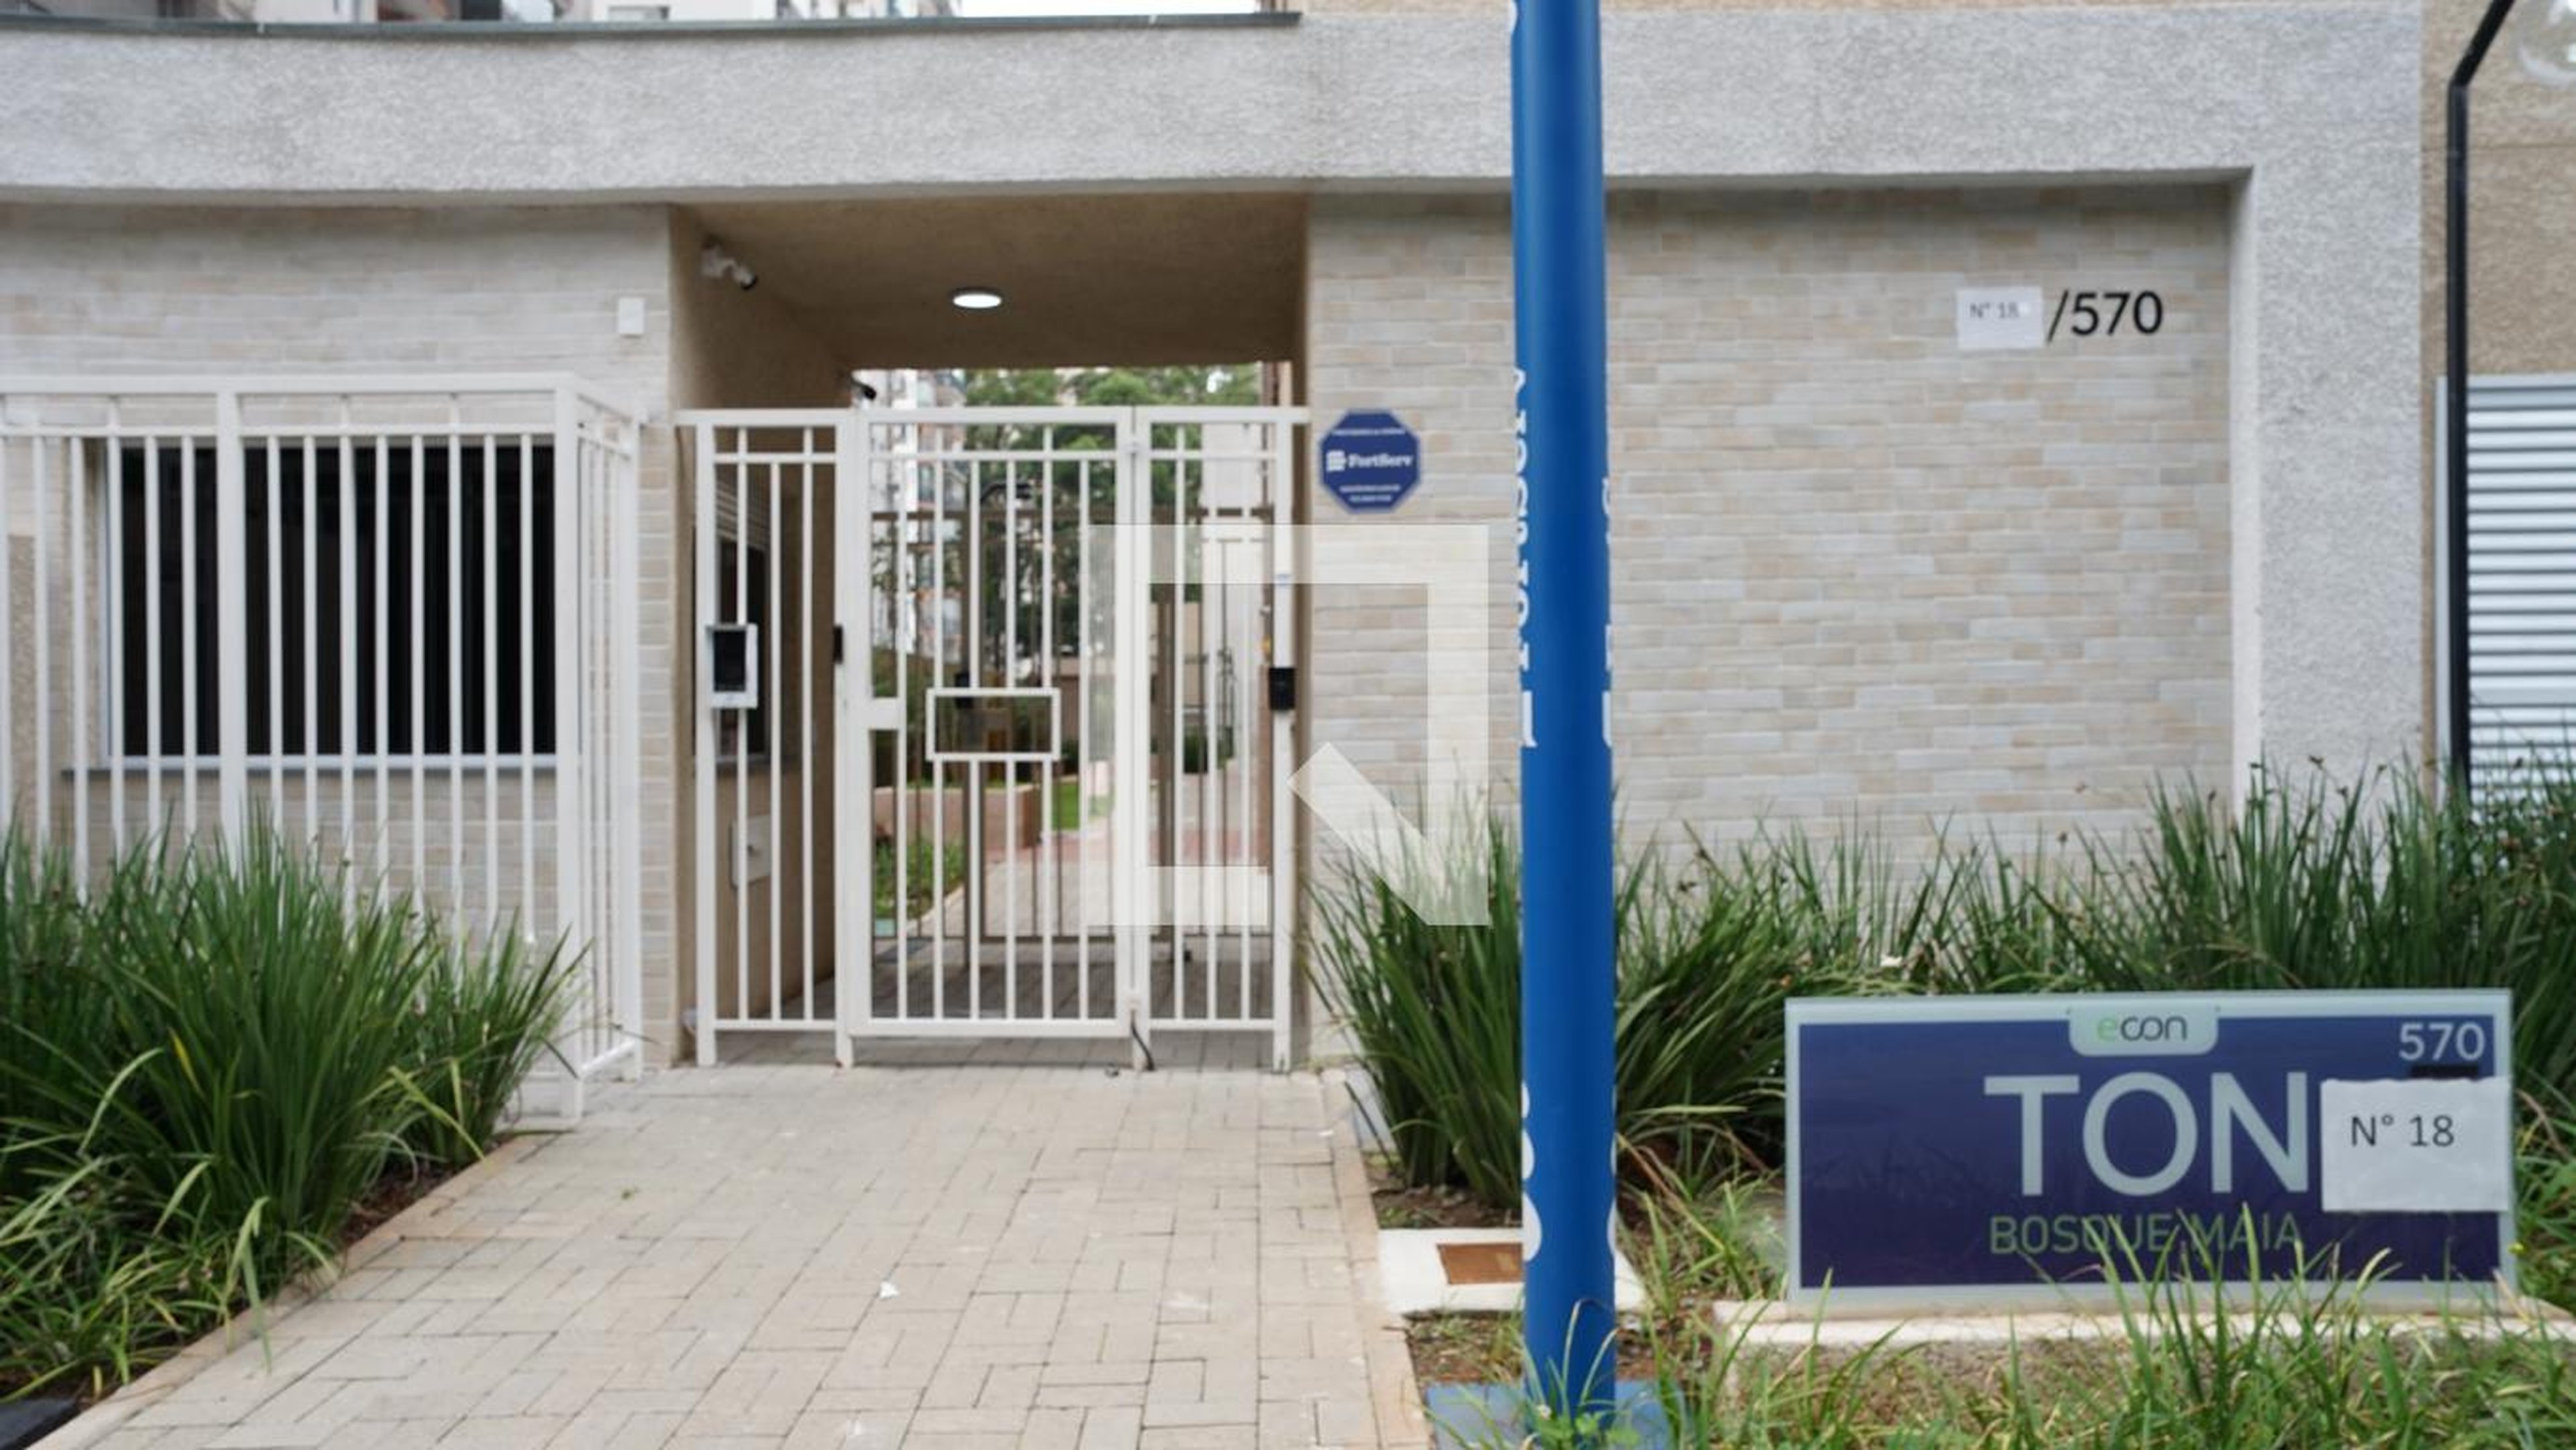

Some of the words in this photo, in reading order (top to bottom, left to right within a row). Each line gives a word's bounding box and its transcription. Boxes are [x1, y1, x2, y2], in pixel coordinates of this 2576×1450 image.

[2096, 1014, 2188, 1042] econ
[2399, 1023, 2484, 1061] 570
[1984, 1072, 2308, 1195] TON
[2409, 1115, 2455, 1147] 18
[1990, 1213, 2172, 1254] BOSQUE
[2190, 1213, 2302, 1253] MAIA
